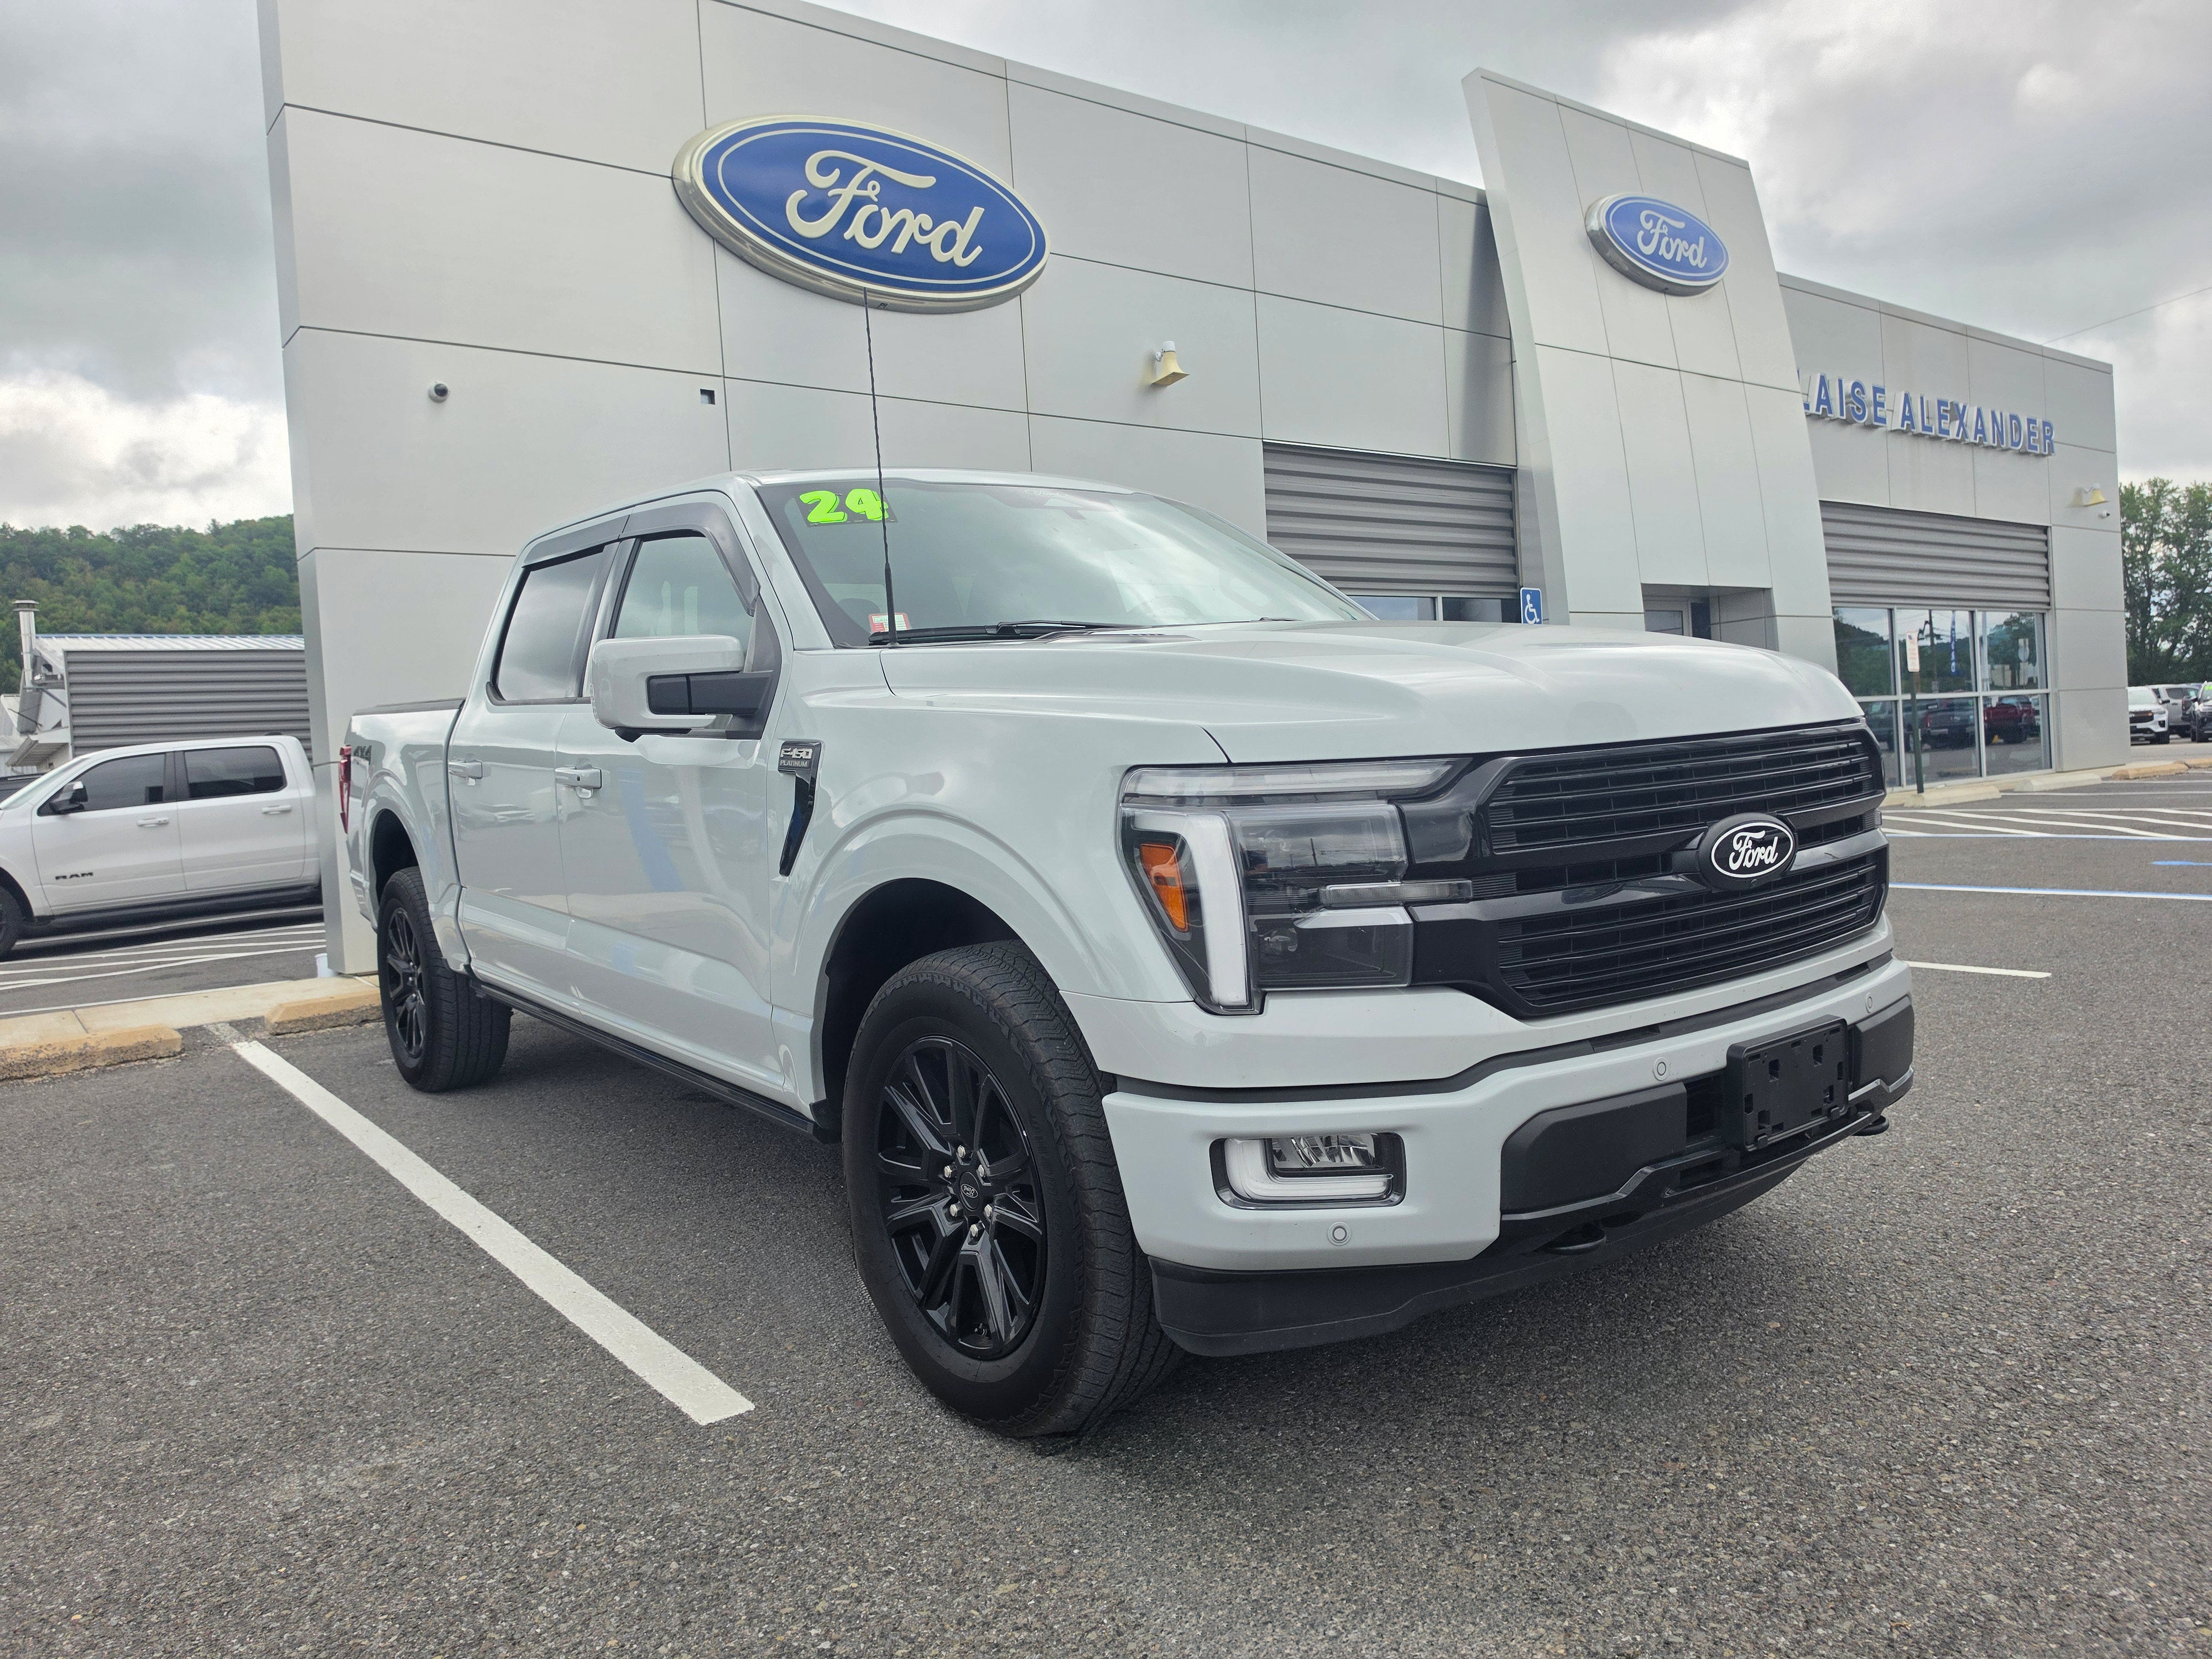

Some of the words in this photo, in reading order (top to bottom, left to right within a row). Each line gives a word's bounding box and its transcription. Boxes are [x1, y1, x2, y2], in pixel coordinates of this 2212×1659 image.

[786, 150, 984, 268] Ford
[1637, 209, 1707, 269] Ford
[1797, 369, 1887, 426] AISE
[1898, 391, 2055, 455] ALEXANDER
[799, 488, 889, 523] 24
[780, 747, 813, 759] F-150
[1729, 830, 1778, 870] Ford
[55, 872, 93, 880] RAM
